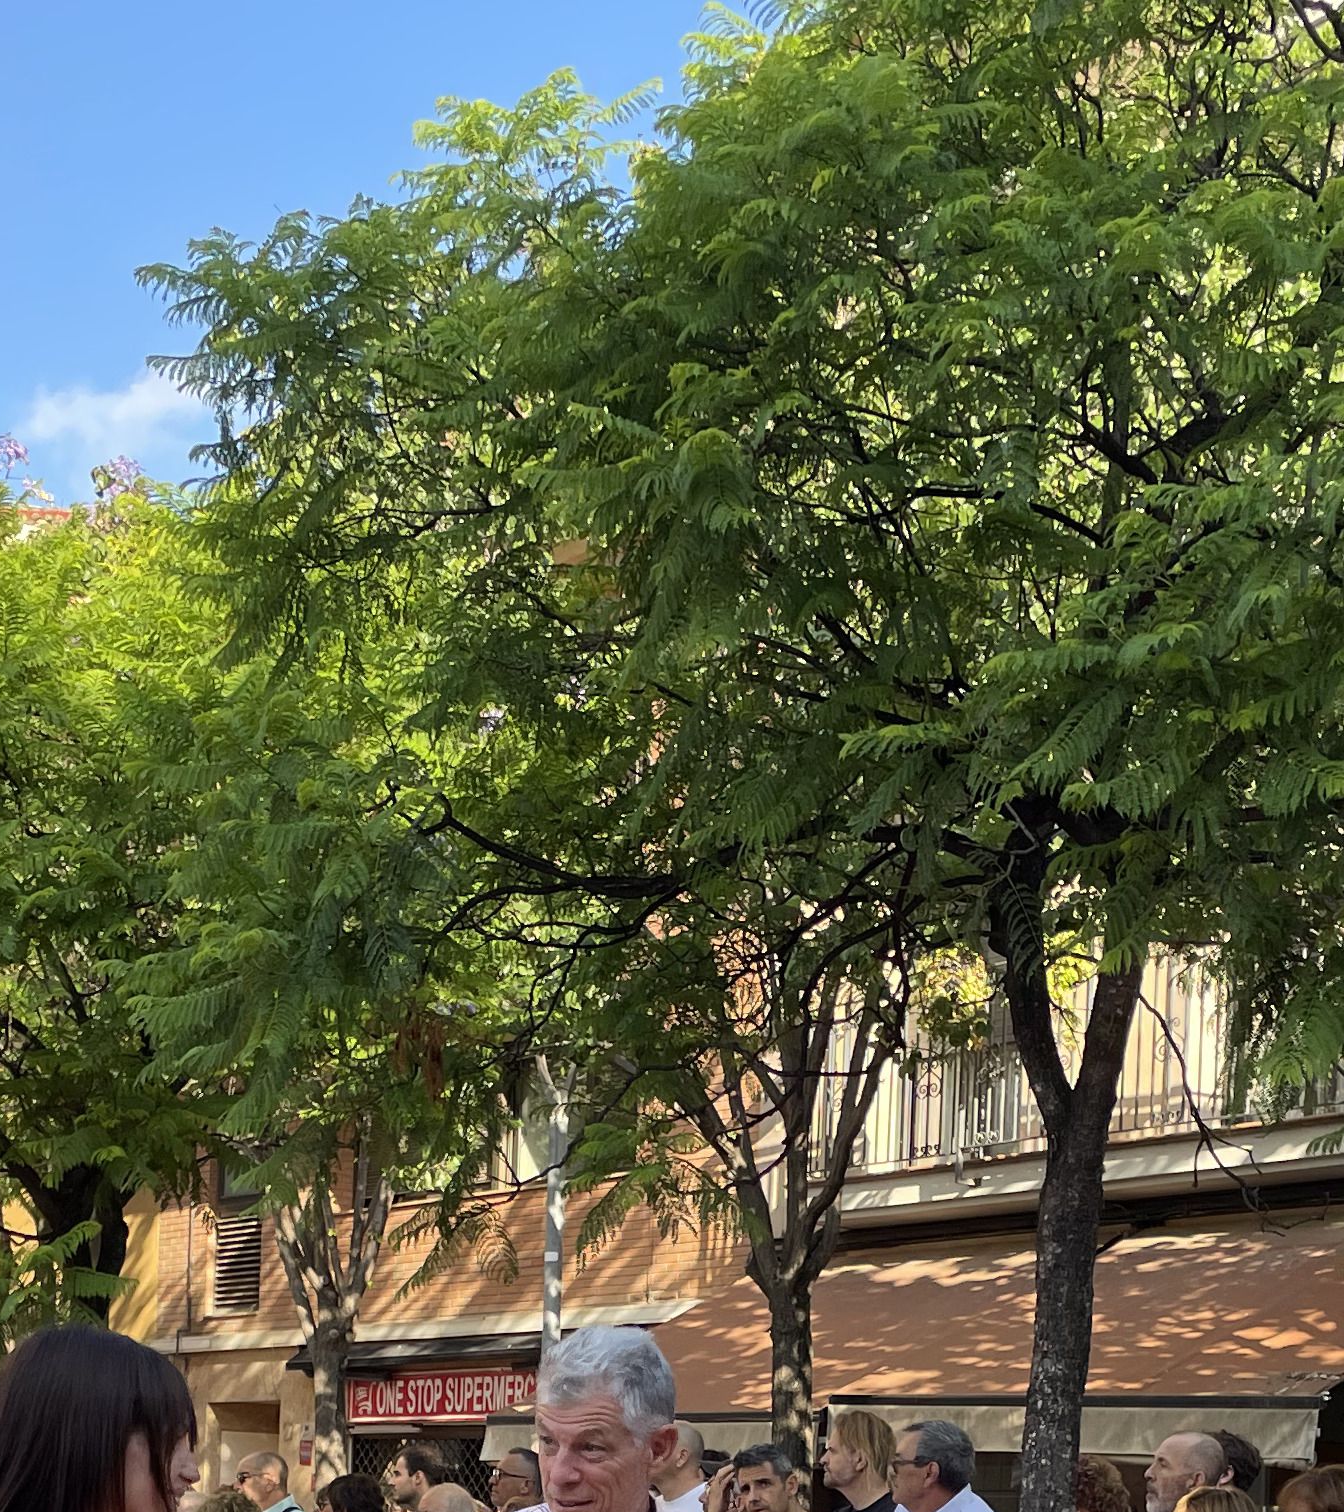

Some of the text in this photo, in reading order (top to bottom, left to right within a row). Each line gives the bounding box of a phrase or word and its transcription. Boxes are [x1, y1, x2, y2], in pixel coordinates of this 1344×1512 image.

[376, 1374, 536, 1416] ONE STOP SUPERMERC
